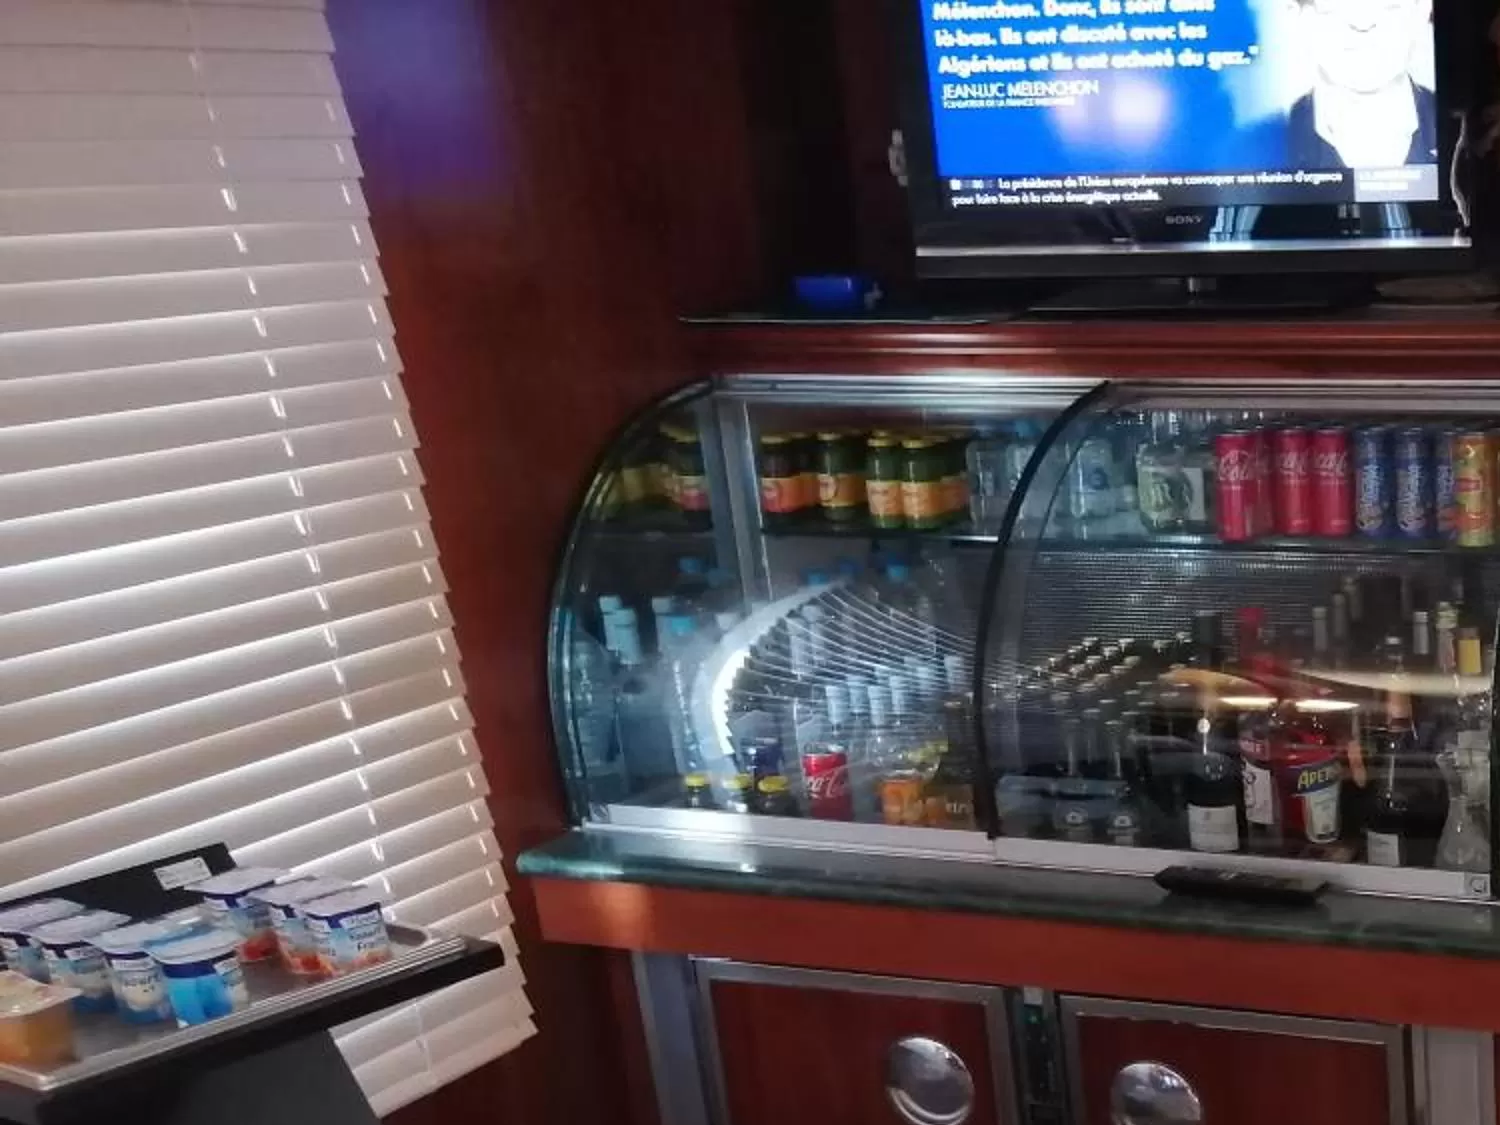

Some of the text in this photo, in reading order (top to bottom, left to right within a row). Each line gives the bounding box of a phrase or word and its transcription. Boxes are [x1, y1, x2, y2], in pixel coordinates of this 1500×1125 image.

[1178, 21, 1207, 39] les
[1177, 49, 1205, 67] du
[1165, 215, 1203, 225] SONY
